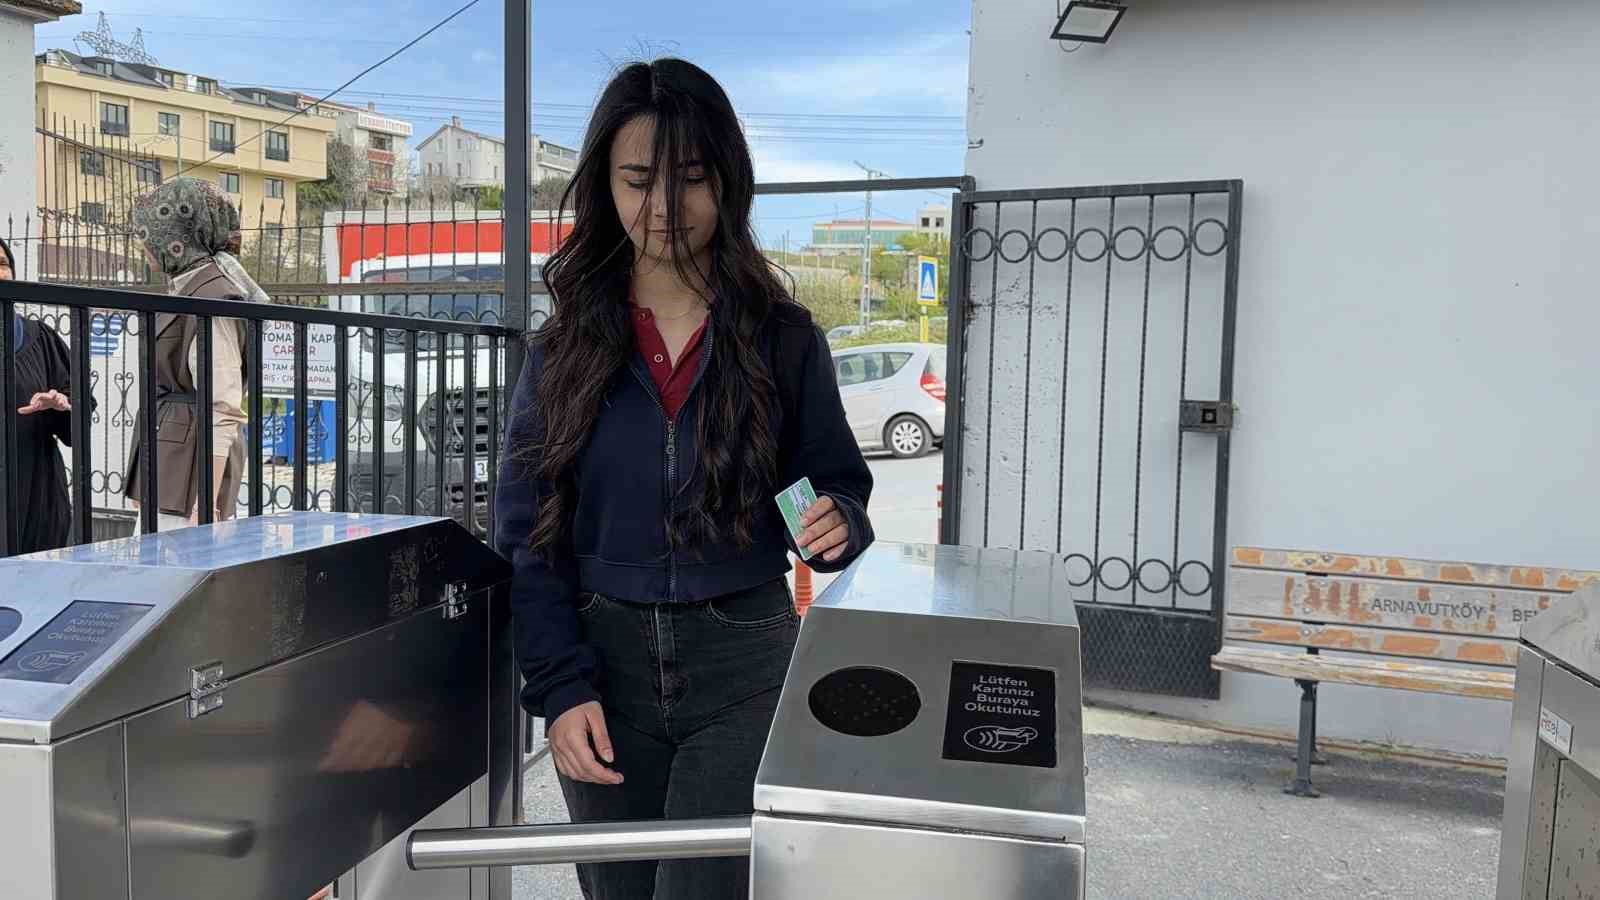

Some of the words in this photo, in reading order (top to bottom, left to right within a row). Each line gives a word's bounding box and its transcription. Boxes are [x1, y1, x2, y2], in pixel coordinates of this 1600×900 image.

[1371, 598, 1485, 620] ARNAVUTKÖY
[979, 675, 1028, 687] Lütfen
[971, 683, 1034, 697] Kartınızı
[976, 693, 1029, 707] Buraya
[964, 702, 1041, 717] Okutunuz
